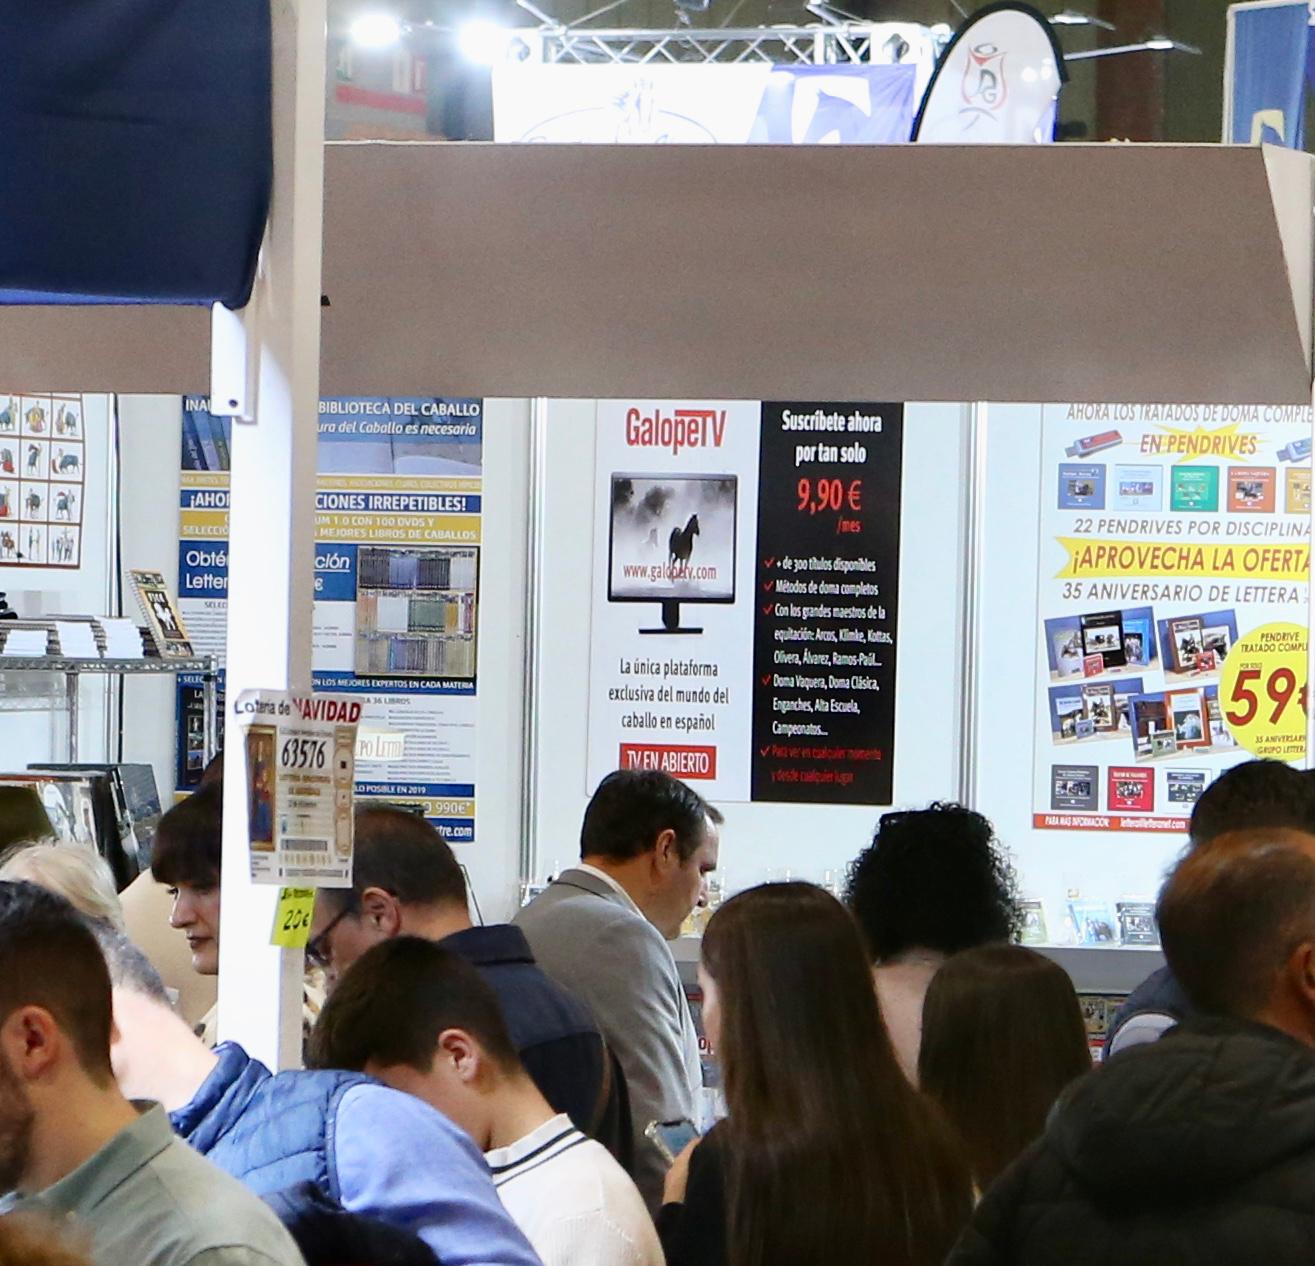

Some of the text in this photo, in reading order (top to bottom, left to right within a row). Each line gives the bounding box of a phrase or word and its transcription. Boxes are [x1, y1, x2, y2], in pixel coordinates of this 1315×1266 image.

[318, 402, 480, 417] BIBLIOTECA DEL CABALLO
[1066, 404, 1109, 420] AHORA
[1114, 404, 1136, 421] LOS
[1138, 404, 1200, 422] TRATADOS
[1203, 405, 1219, 422] DE
[1220, 405, 1260, 423] DOMA
[341, 421, 476, 436] del Caballo es necesaria
[782, 409, 882, 432] Suscríbete ahora
[626, 407, 727, 455] GalopeTV
[1140, 434, 1258, 454] EN PENDRIVES
[795, 442, 867, 466] por tan solo
[315, 494, 365, 509] CIONES
[368, 496, 466, 511] IRREPETIBLES!
[798, 478, 862, 514] 9,90 €
[352, 518, 373, 526] CON
[836, 517, 862, 534] /mes
[1074, 518, 1092, 534] 22
[1098, 519, 1183, 535] PENDRIVES
[1188, 520, 1220, 536] POR
[320, 528, 477, 540] MEJORES LIBROS DE CABALLOS
[315, 554, 350, 570] ción
[782, 556, 792, 570] de
[794, 560, 808, 573] 300
[834, 557, 876, 574] disponibles
[1072, 546, 1208, 574] ¡APROVECHA
[1212, 548, 1236, 572] LA
[623, 563, 717, 582] www.galopetv.com
[776, 580, 879, 598] Métodos de doma completos
[1062, 582, 1082, 600] 35
[1087, 584, 1202, 602] ANIVERSARIO
[1208, 585, 1230, 602] DE
[1235, 586, 1299, 604] LETTERA
[774, 602, 886, 620] Con los grandes maestros de la
[1260, 632, 1300, 642] PENDRIVE
[1241, 644, 1276, 653] TRATADO
[620, 657, 718, 678] La única plataforma
[420, 681, 442, 689] CADA
[443, 681, 474, 690] MATERIA
[774, 674, 795, 688] Doma
[828, 674, 850, 689] Doma
[608, 684, 730, 704] exclusiva del mundo del
[622, 712, 715, 734] caballo en español
[1256, 736, 1264, 744] 35
[281, 737, 325, 769] 63576
[627, 750, 710, 774] TV EN ABIERTO
